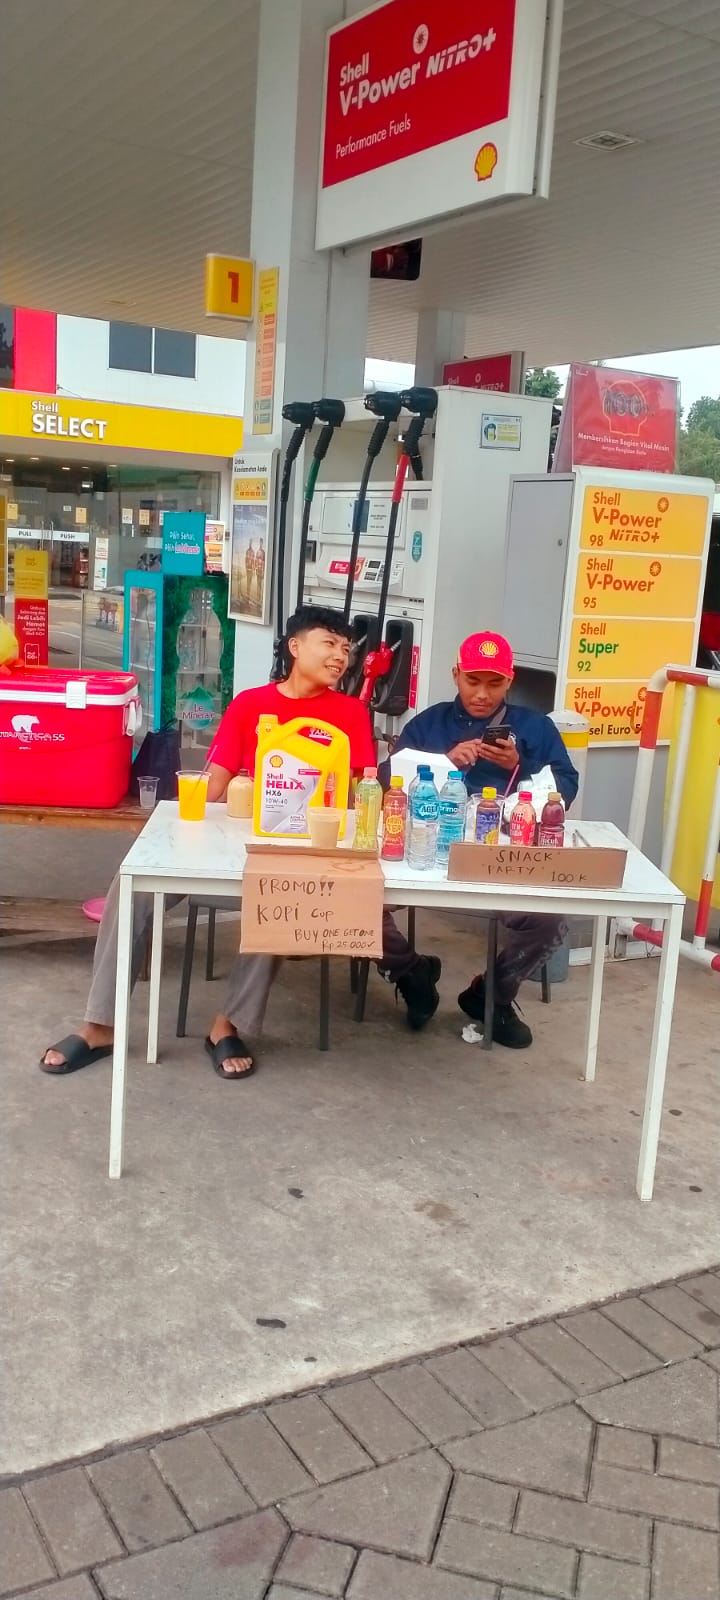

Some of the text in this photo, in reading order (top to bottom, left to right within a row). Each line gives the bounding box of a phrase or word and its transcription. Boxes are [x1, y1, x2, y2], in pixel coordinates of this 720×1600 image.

[340, 52, 370, 86] Shell
[339, 61, 420, 117] V-Power
[335, 113, 412, 159] Performance Fuels
[228, 271, 240, 304] 1
[31, 400, 59, 412] Shell
[31, 414, 108, 441] SELECT
[619, 438, 640, 448] Bagian
[640, 440, 653, 450] Vital
[653, 443, 670, 452] Mesin
[593, 491, 620, 506] Shell
[592, 507, 662, 528] V-Power
[589, 534, 604, 547] 98
[586, 558, 613, 571] Shell
[586, 573, 655, 592] V-Power
[583, 596, 597, 609] 95
[580, 622, 606, 636] Shell
[578, 638, 619, 658] Super
[577, 660, 591, 672] 92
[574, 687, 601, 700] Shell
[574, 701, 643, 717] V-Power
[607, 724, 631, 736] Euro
[635, 723, 643, 735] 5
[266, 772, 284, 780] Shell
[265, 779, 305, 791] HELIX
[265, 789, 283, 797] HX6
[265, 797, 289, 806] 10W-40
[551, 871, 574, 883] 100
[295, 929, 319, 943] BUY
[322, 929, 340, 938] ONE
